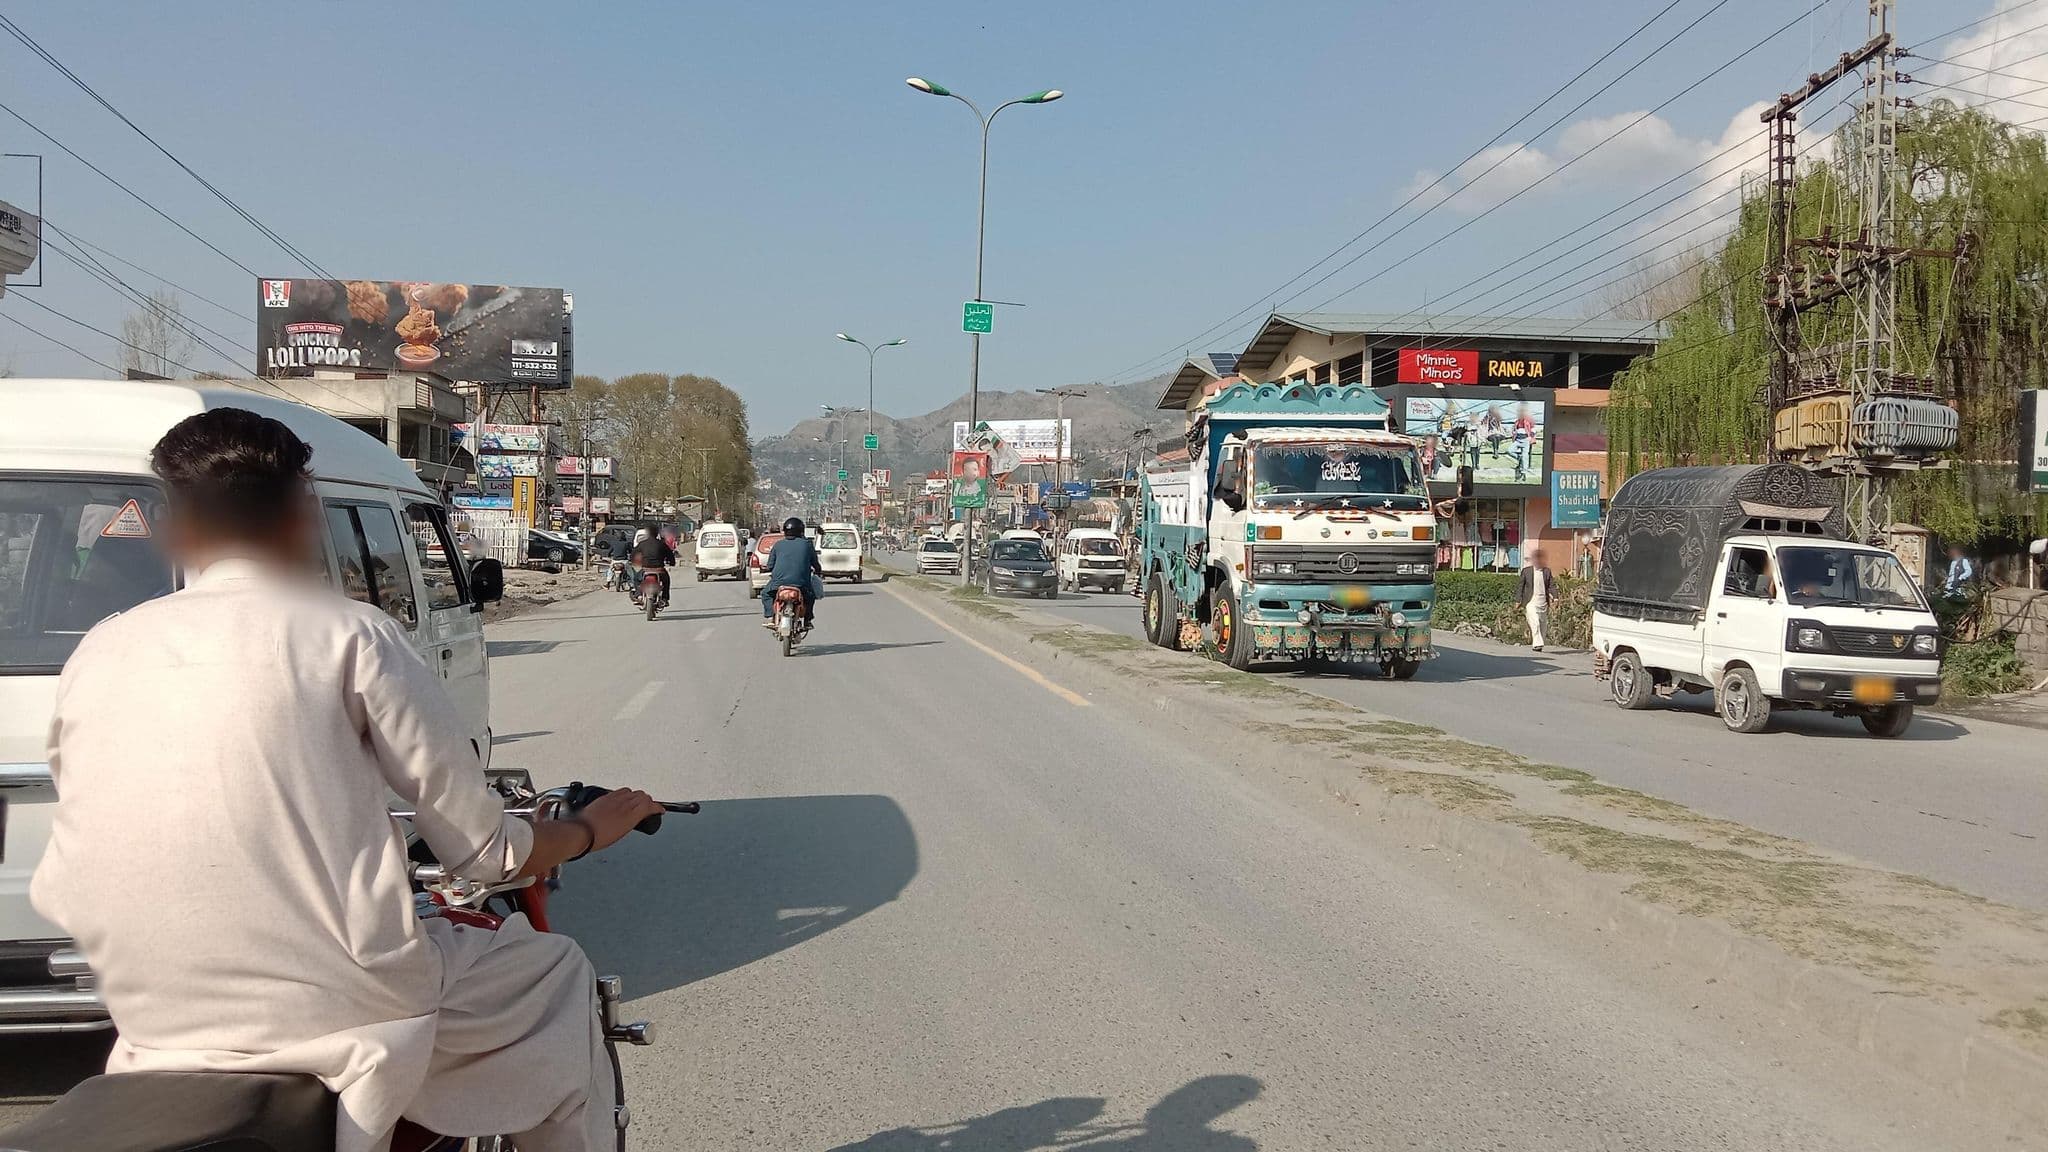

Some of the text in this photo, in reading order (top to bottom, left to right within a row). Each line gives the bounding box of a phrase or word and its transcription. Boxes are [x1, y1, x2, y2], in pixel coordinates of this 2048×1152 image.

[267, 347, 362, 368] LOLLIPOPS
[1416, 353, 1457, 367] Minnie
[1488, 360, 1543, 378] RANG JA
[1559, 474, 1598, 490] GREEN'S
[1558, 494, 1599, 506] Shadi Hall
